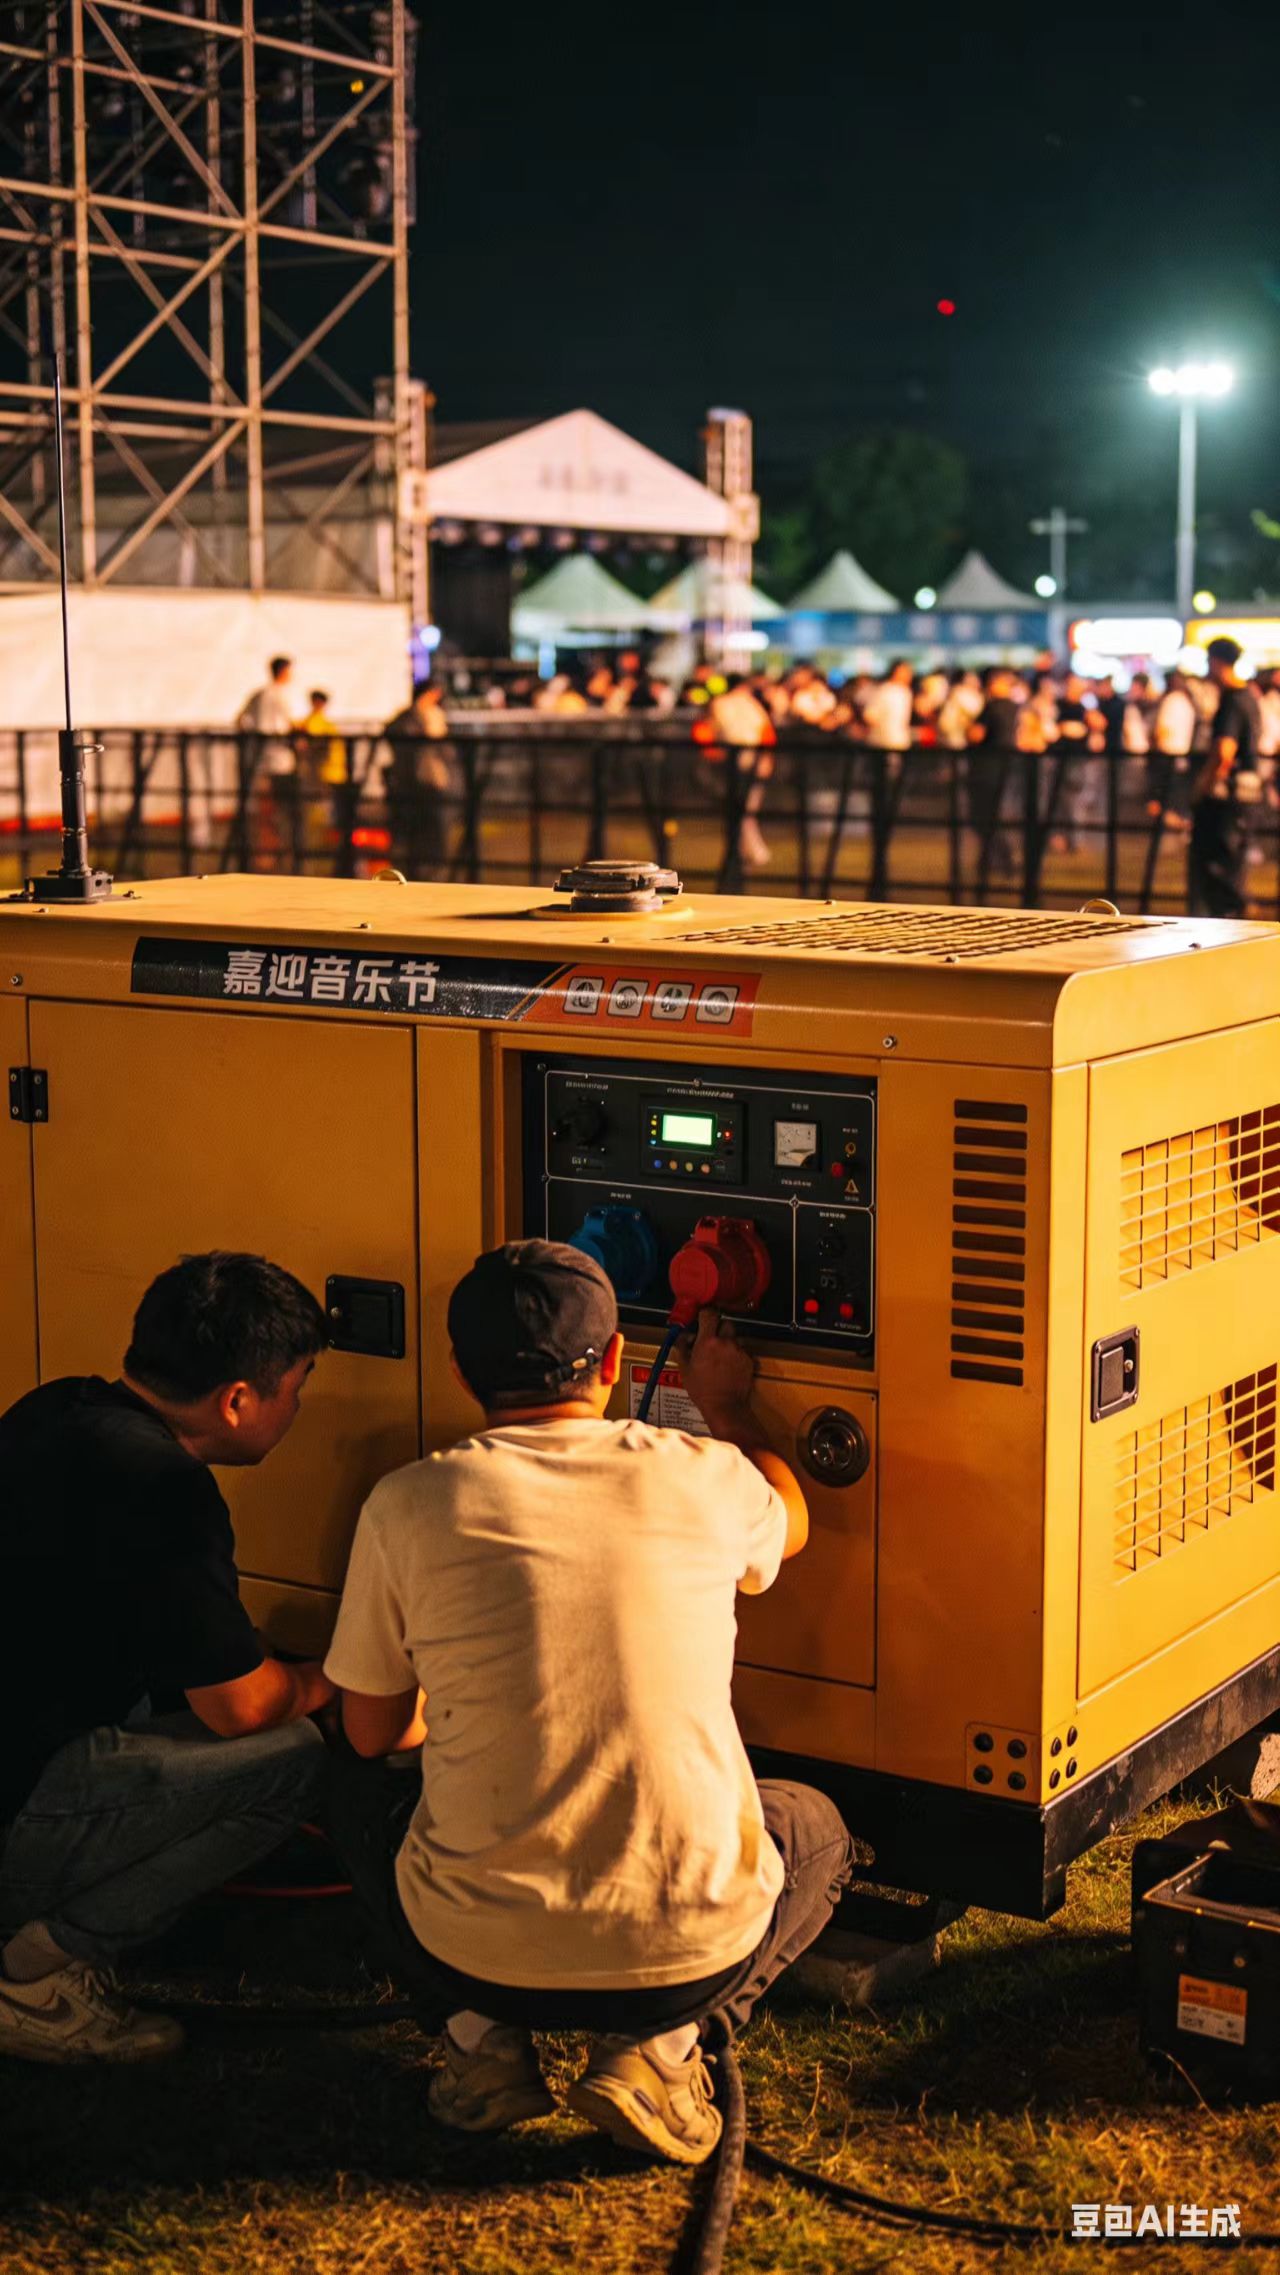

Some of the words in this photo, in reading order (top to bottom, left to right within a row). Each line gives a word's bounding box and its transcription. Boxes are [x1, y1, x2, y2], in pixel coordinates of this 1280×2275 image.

[222, 948, 440, 1007] 嘉迎音乐节
